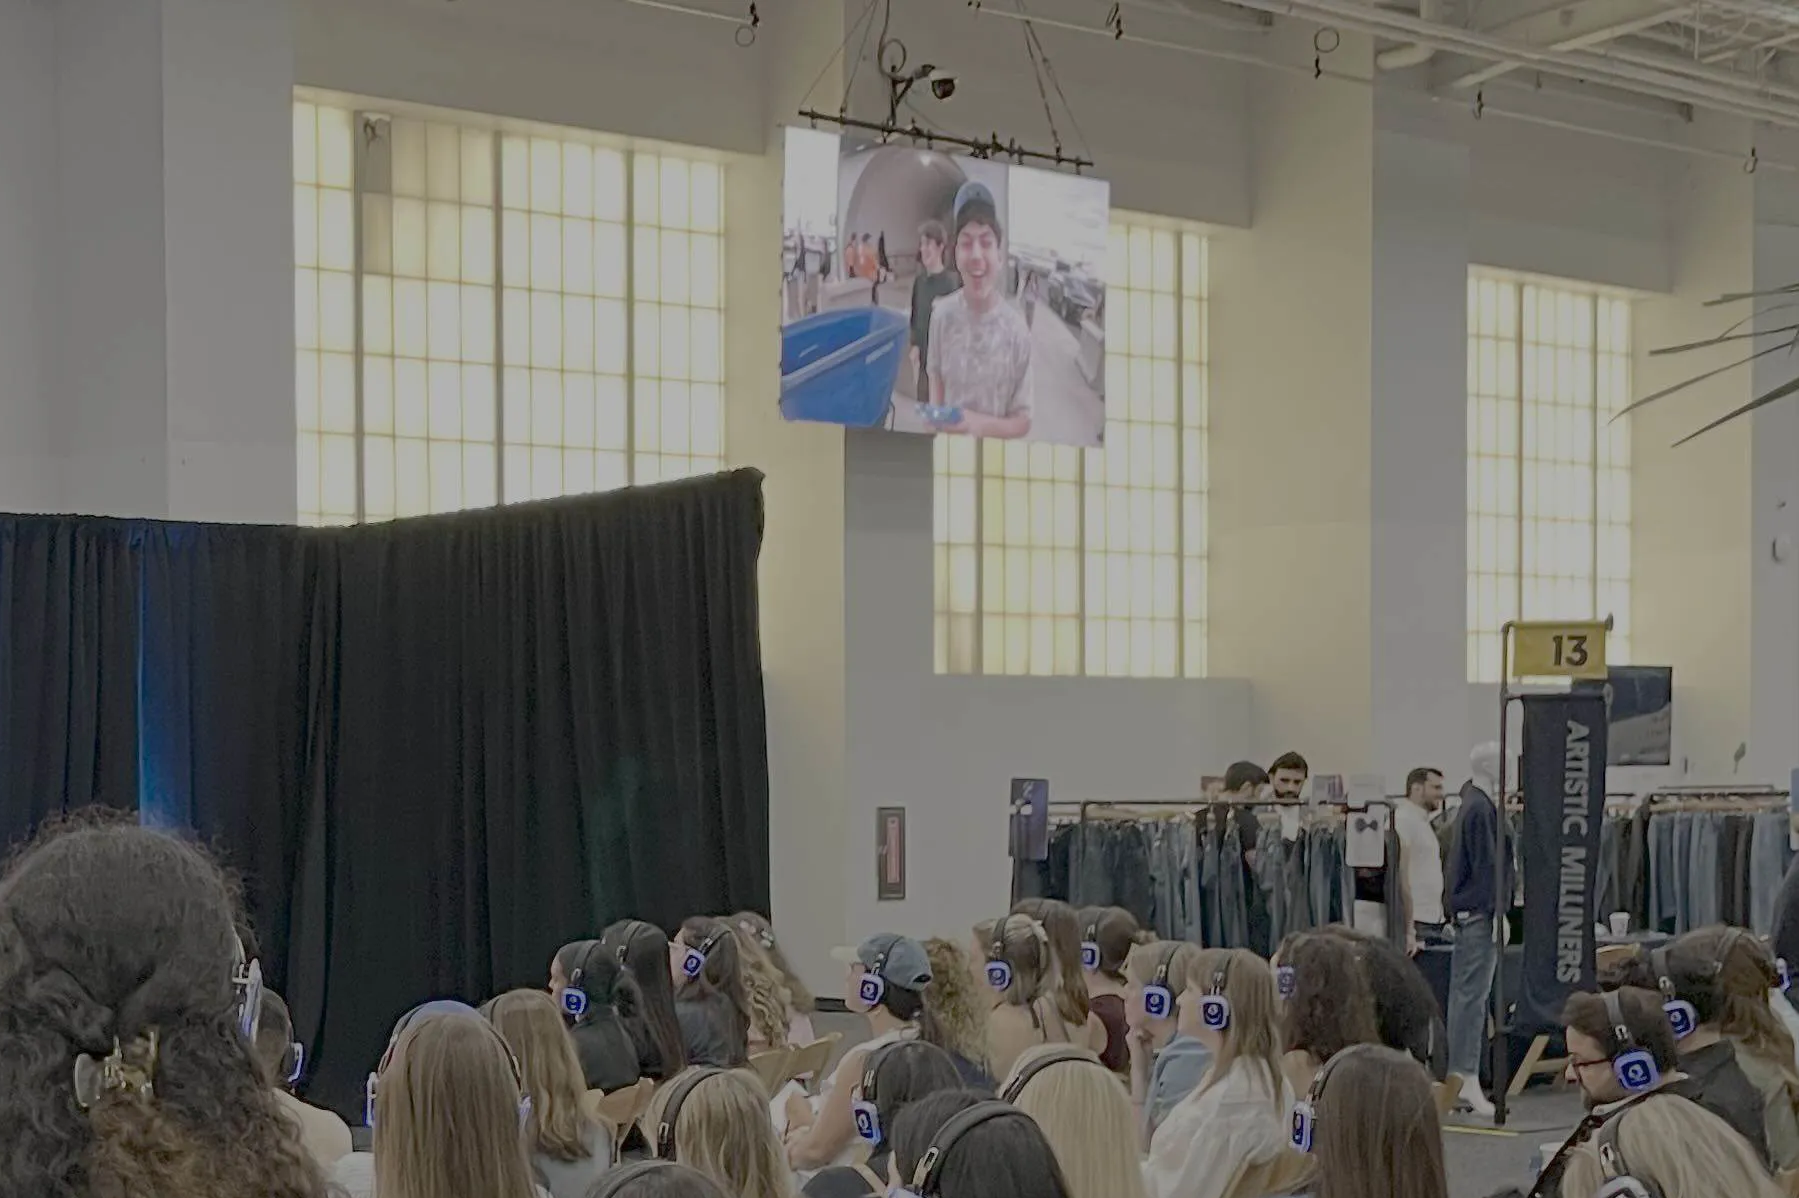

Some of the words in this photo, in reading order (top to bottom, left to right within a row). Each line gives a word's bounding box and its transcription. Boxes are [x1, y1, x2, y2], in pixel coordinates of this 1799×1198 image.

[1552, 635, 1588, 666] 13
[1562, 719, 1591, 838] ARTISTIC
[1556, 847, 1587, 983] MILLINERS
